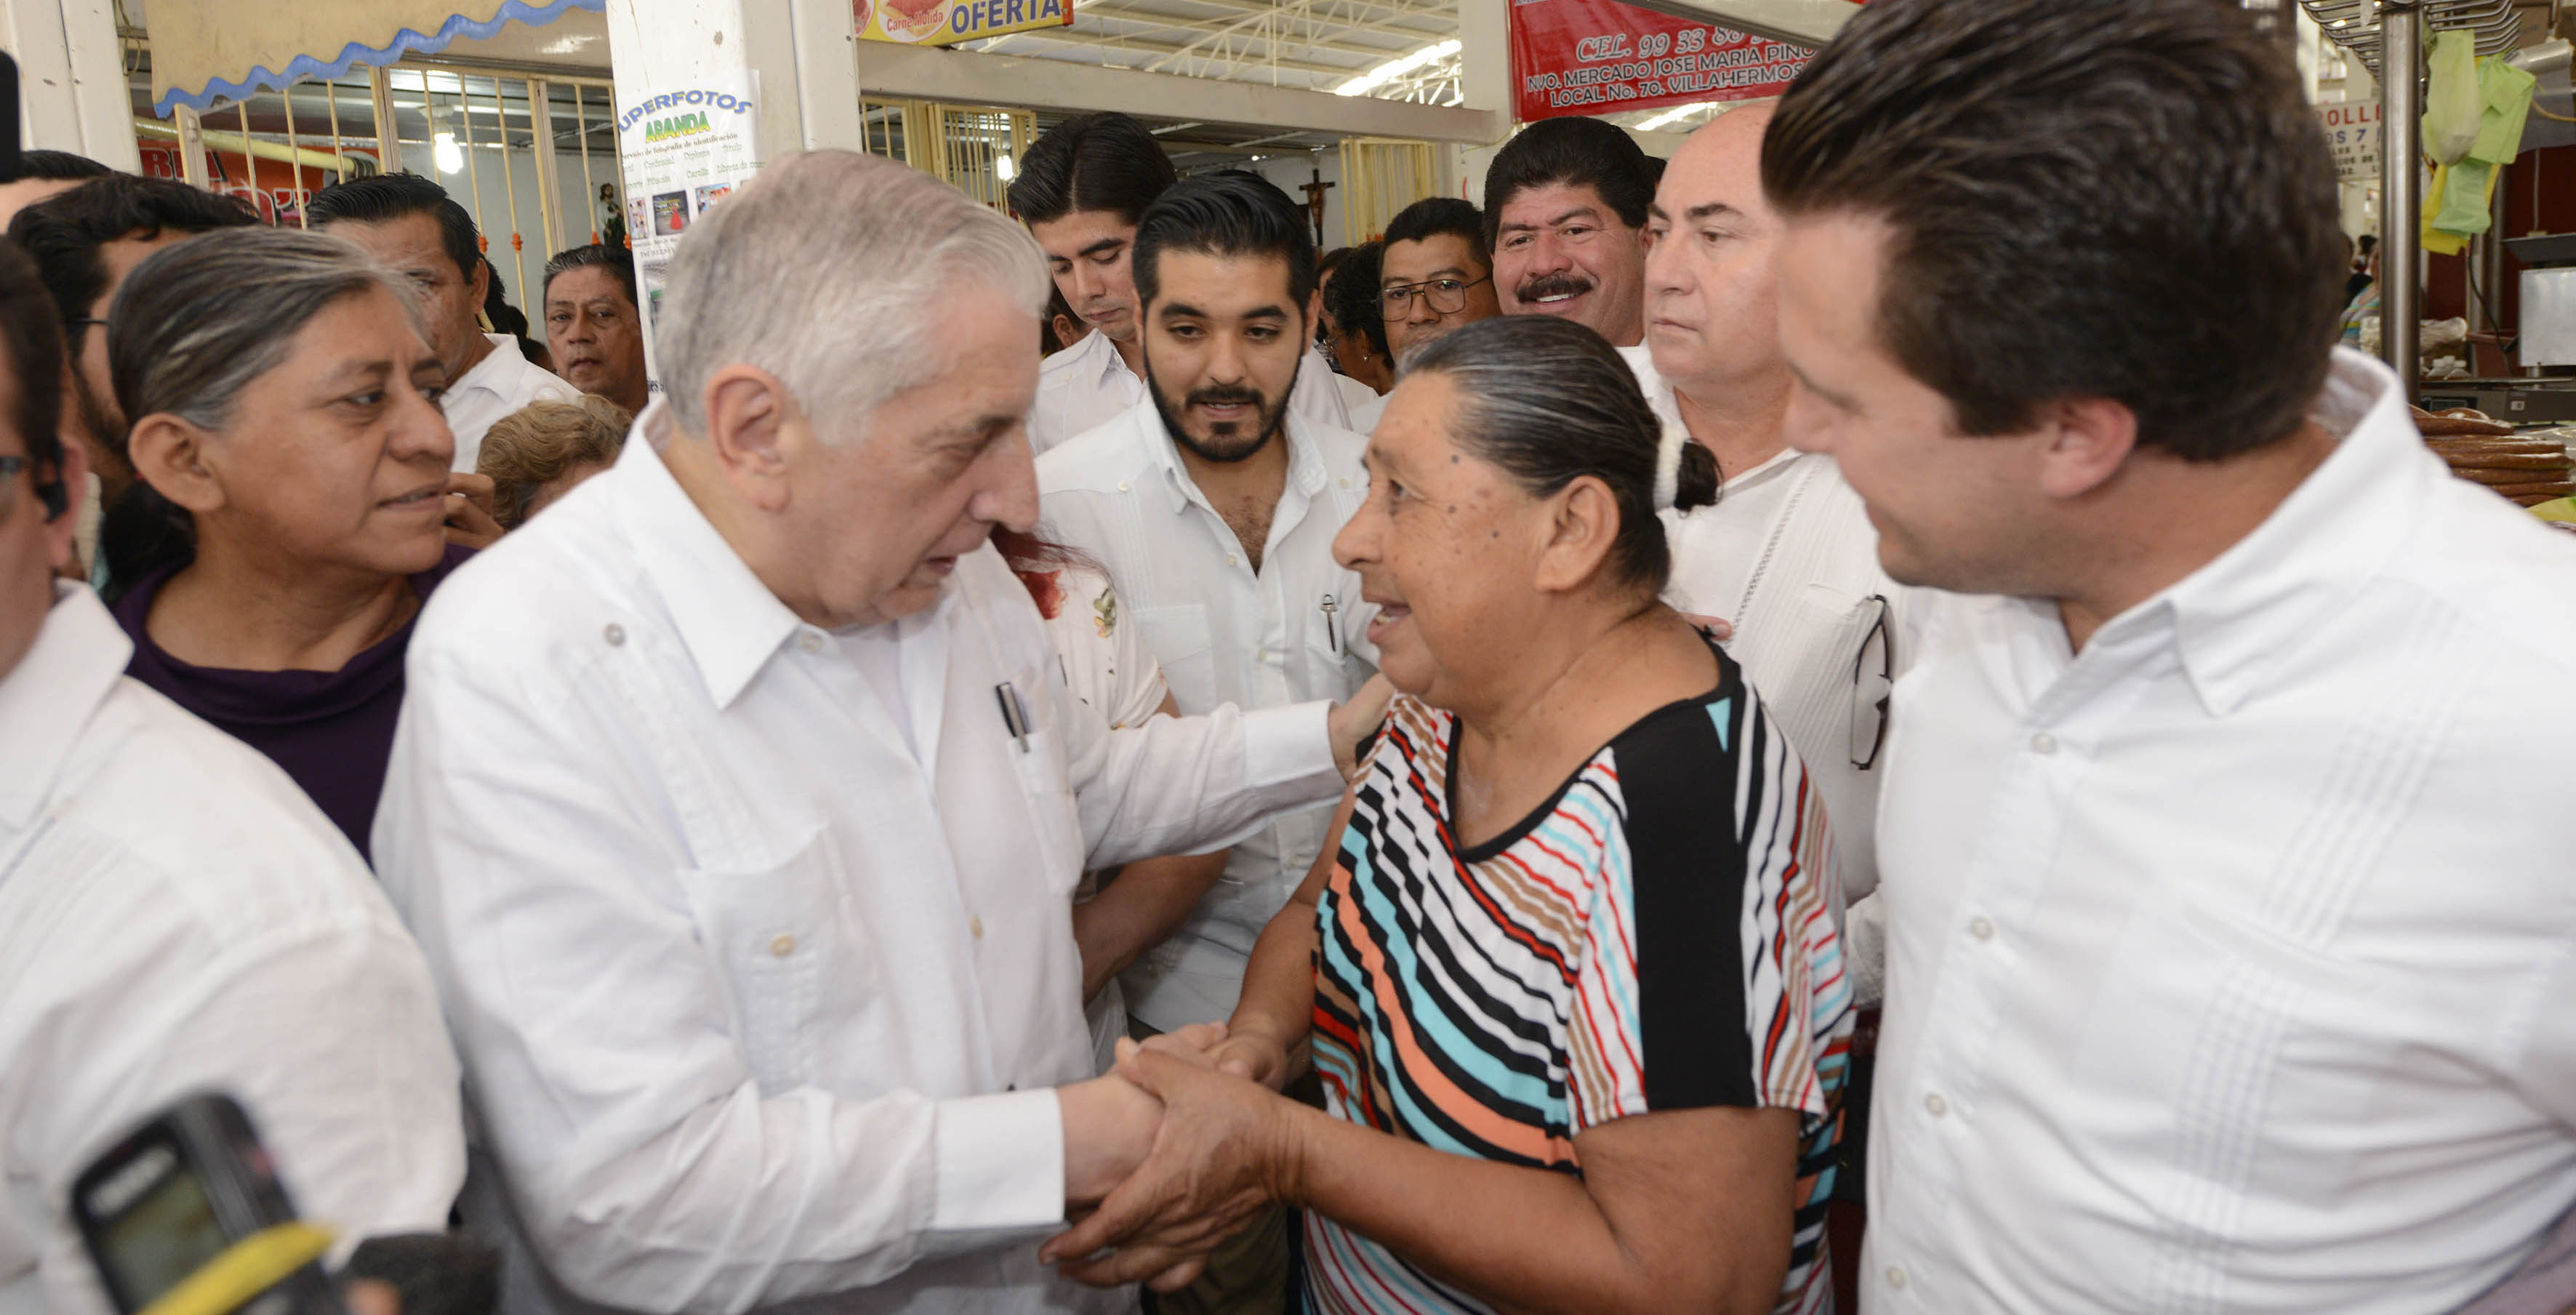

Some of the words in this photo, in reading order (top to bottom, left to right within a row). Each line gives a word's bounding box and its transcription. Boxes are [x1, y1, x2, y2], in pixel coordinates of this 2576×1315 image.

[886, 15, 912, 32] Carne
[914, 10, 944, 31] Molida
[951, 0, 1062, 34] OFERTA
[1576, 33, 1632, 63] CEL.
[1638, 33, 1670, 59] 99
[1674, 27, 1706, 54] 33
[1528, 73, 1562, 92] NVO.
[1563, 60, 1650, 88] MERCADO
[1653, 55, 1695, 79] JOSE
[1699, 47, 1762, 71] MARIA
[1549, 85, 1605, 108] LOCAL
[1607, 84, 1637, 100] No.
[1638, 81, 1666, 98] 70.
[1667, 60, 1810, 93] VILLAHERMOS
[645, 110, 711, 144] ARANDA
